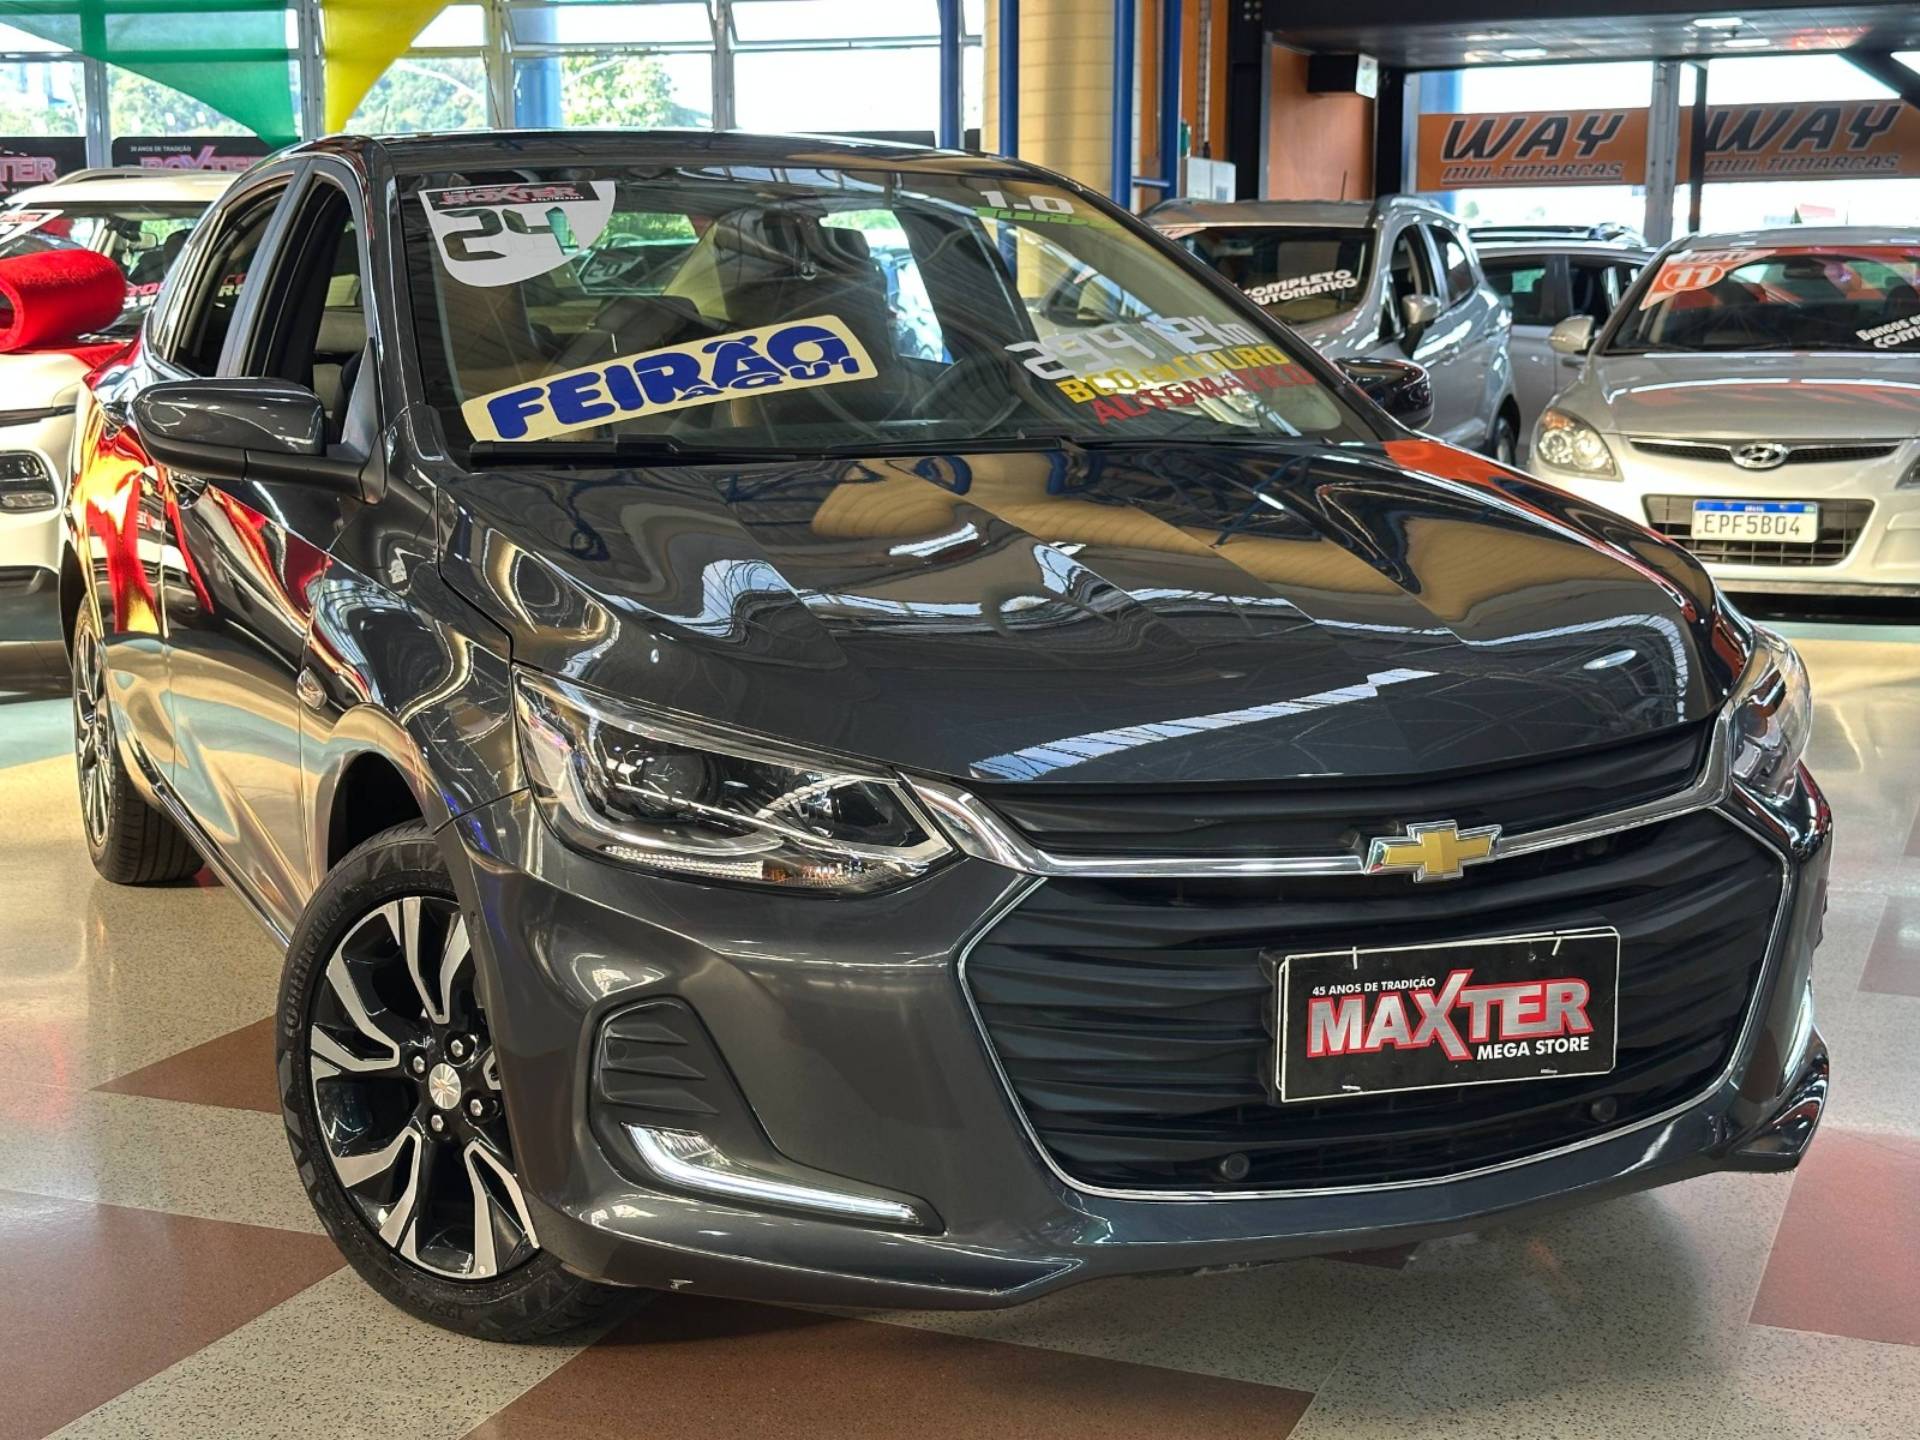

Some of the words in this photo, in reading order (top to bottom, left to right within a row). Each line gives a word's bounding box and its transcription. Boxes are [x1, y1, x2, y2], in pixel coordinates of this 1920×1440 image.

[1440, 113, 1626, 162] WAY
[1701, 105, 1902, 153] WAY
[1441, 163, 1623, 179] MULTIMARCAS
[980, 190, 1075, 215] 1.0
[439, 206, 581, 262] 24
[1243, 269, 1352, 297] OMPLETO
[1673, 266, 1718, 289] 11
[487, 325, 850, 440] FEIRÃO
[1055, 367, 1138, 405] BCO
[1176, 344, 1291, 379] COURO
[1703, 513, 1801, 536] EPF5B04
[1312, 986, 1326, 996] 45
[1328, 983, 1362, 995] ANOS
[1364, 982, 1379, 992] DE
[1381, 976, 1436, 991] TRADIÇÃO
[1307, 968, 1595, 1061] MAXTER
[1476, 1041, 1531, 1061] MEGA
[1535, 1036, 1590, 1056] STORE
